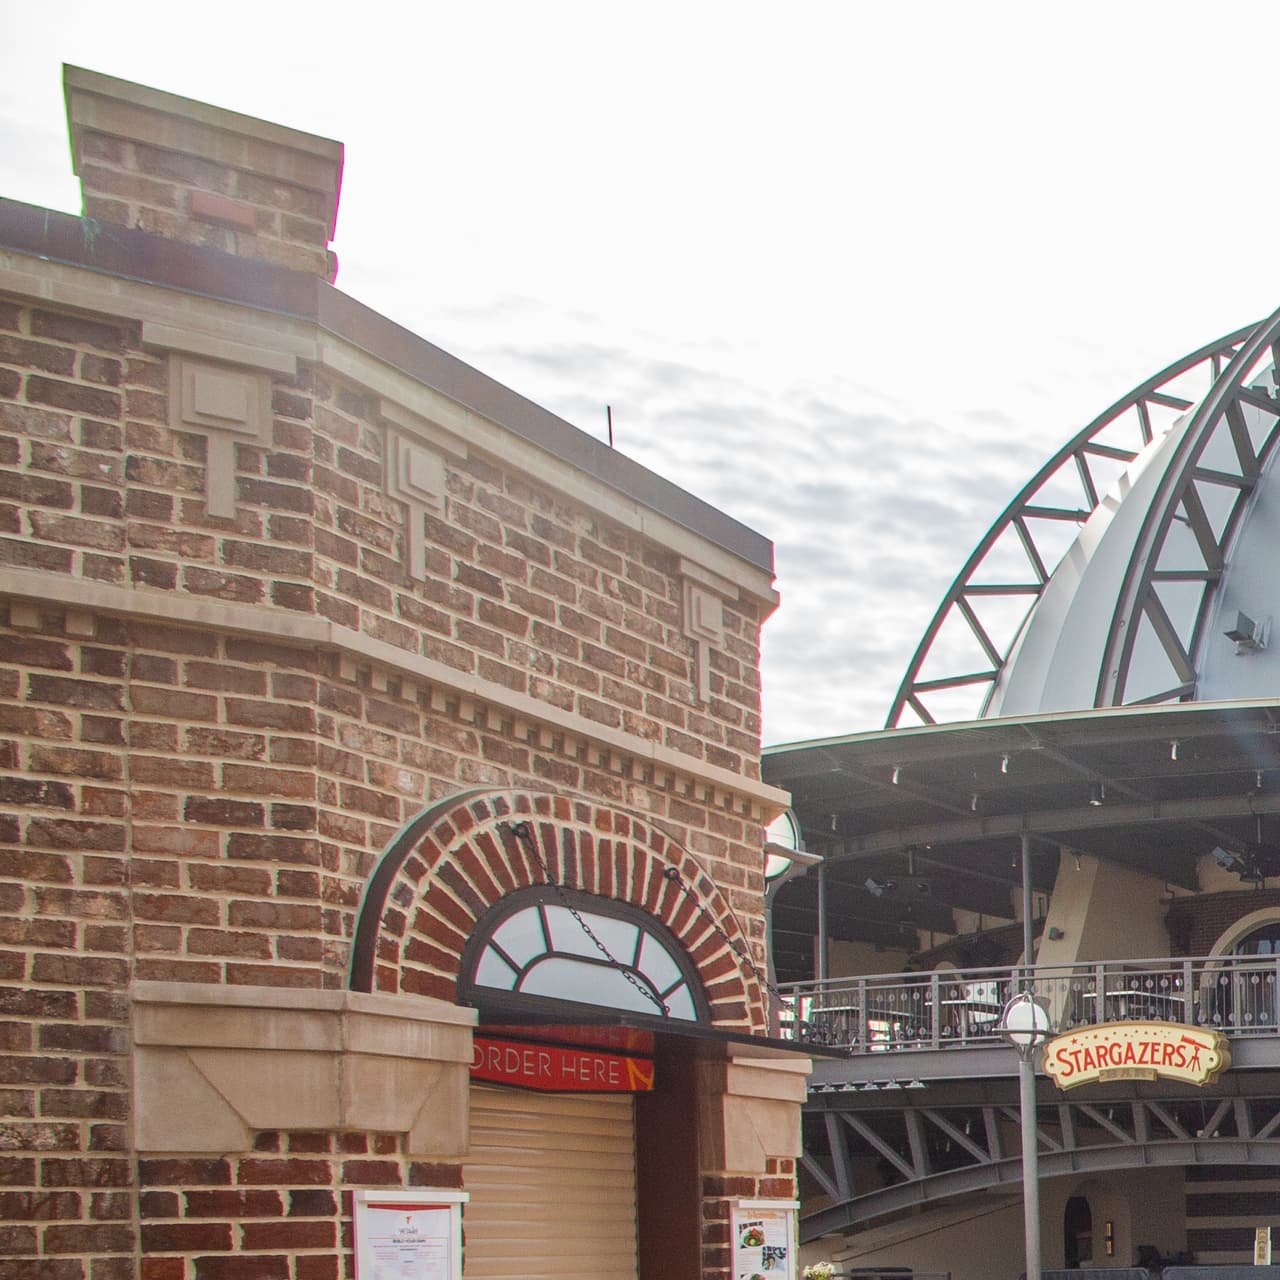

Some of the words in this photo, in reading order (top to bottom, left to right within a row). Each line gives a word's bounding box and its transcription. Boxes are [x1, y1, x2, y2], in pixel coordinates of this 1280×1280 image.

[469, 1045, 552, 1077] ORDER
[561, 1055, 621, 1085] HERE
[1055, 1041, 1188, 1077] STARGAZERS
